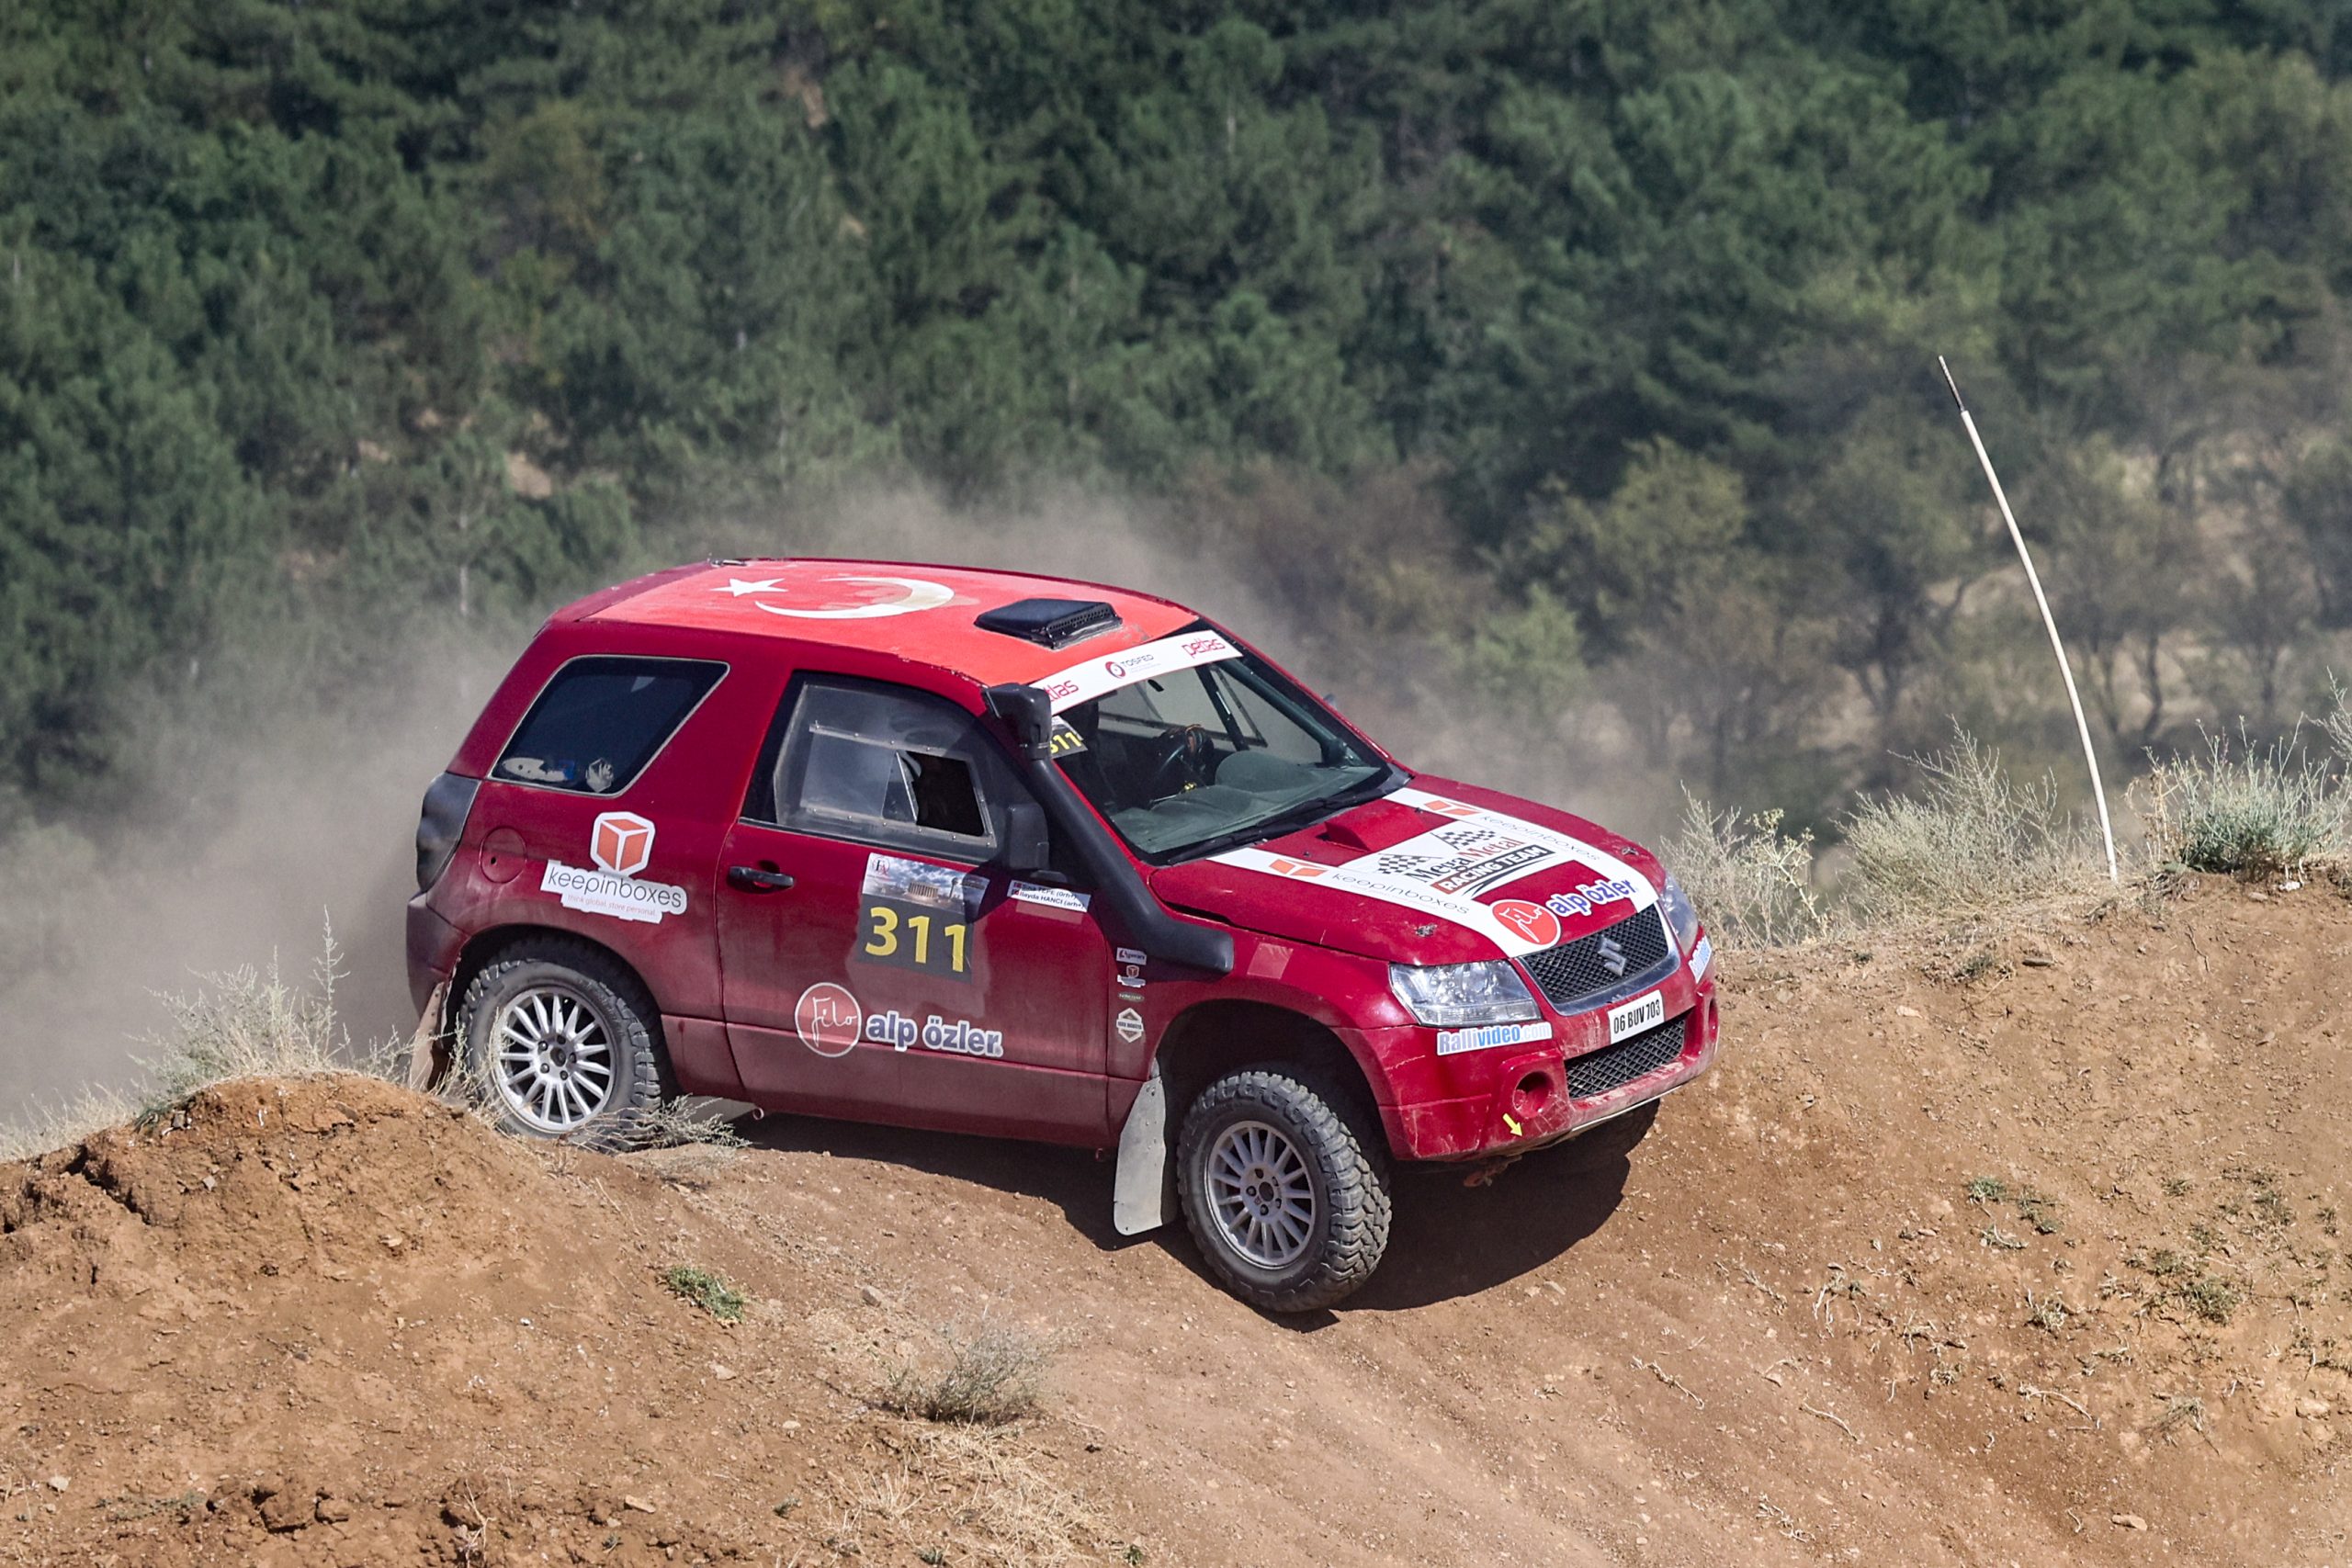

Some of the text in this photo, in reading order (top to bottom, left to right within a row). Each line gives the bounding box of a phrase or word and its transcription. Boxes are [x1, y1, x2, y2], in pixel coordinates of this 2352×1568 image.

[1120, 653, 1154, 667] TOSFED
[1182, 637, 1226, 659] petlas
[1404, 836, 1526, 883] MegaMetal
[1437, 845, 1548, 892] RACING TEAM
[548, 866, 683, 908] keepinboxes
[1332, 873, 1470, 915] keepinboxes
[1550, 879, 1637, 914] alp özler
[865, 906, 967, 973] 311
[868, 1013, 1001, 1054] alp özler
[1613, 998, 1661, 1034] 06 BUV 703
[1438, 1021, 1552, 1055] Rallivideo.com
